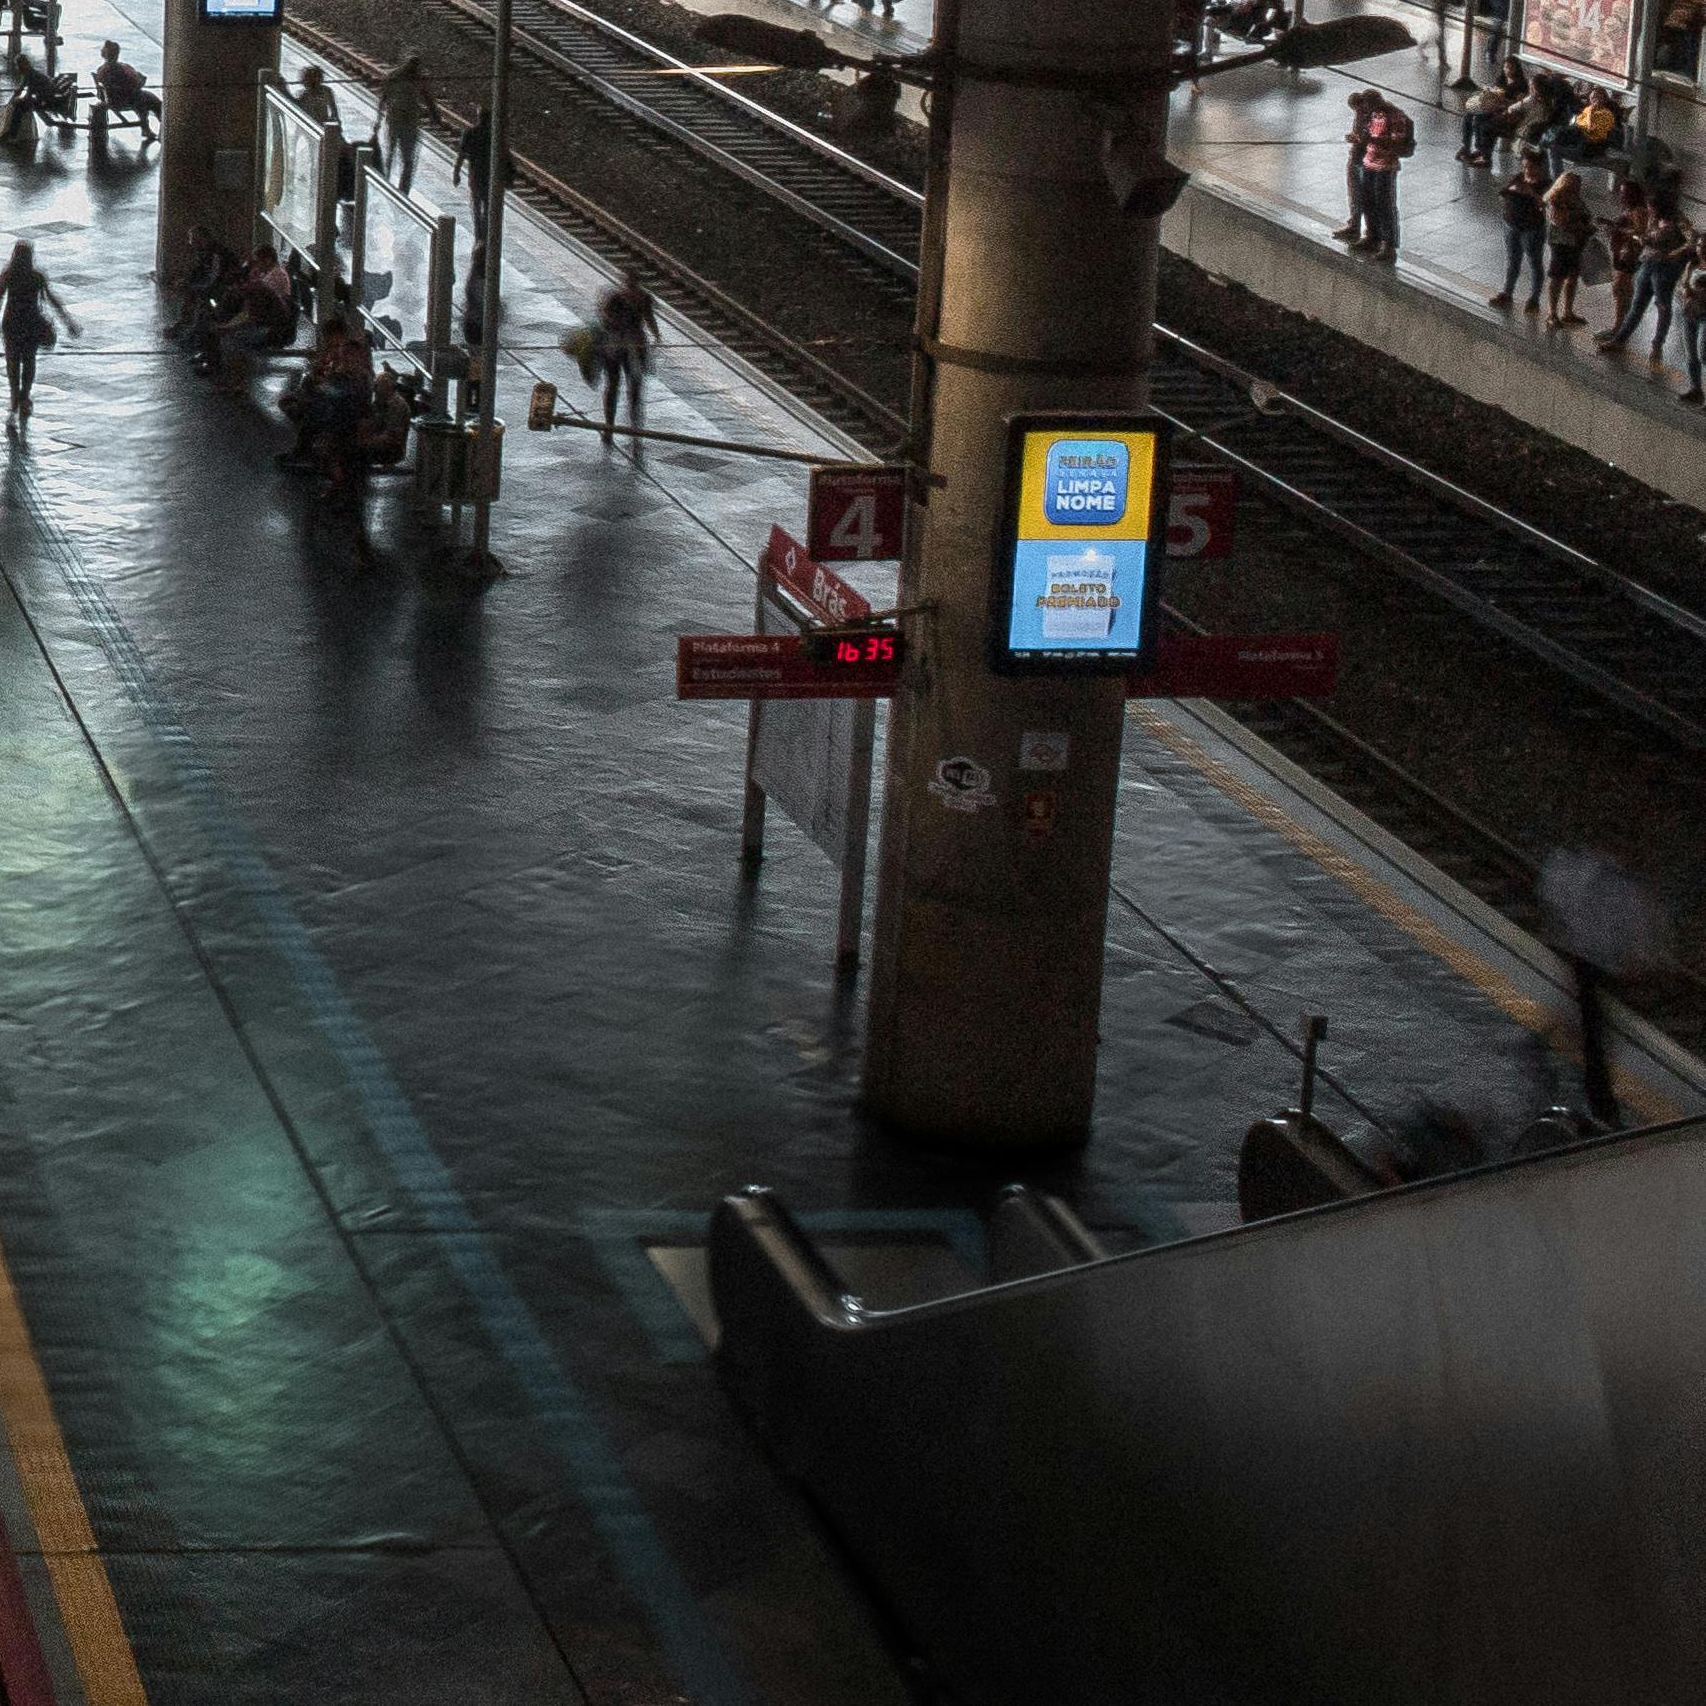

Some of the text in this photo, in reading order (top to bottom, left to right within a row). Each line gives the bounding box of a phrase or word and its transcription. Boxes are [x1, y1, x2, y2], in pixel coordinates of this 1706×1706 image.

[1057, 480, 1117, 494] LIMPA
[1056, 495, 1116, 510] NOME
[829, 495, 884, 558] 4
[1165, 493, 1213, 557] 5
[1051, 583, 1107, 593] BOLETO
[1036, 596, 1121, 608] PREMIADO
[692, 641, 769, 654] Plataforma
